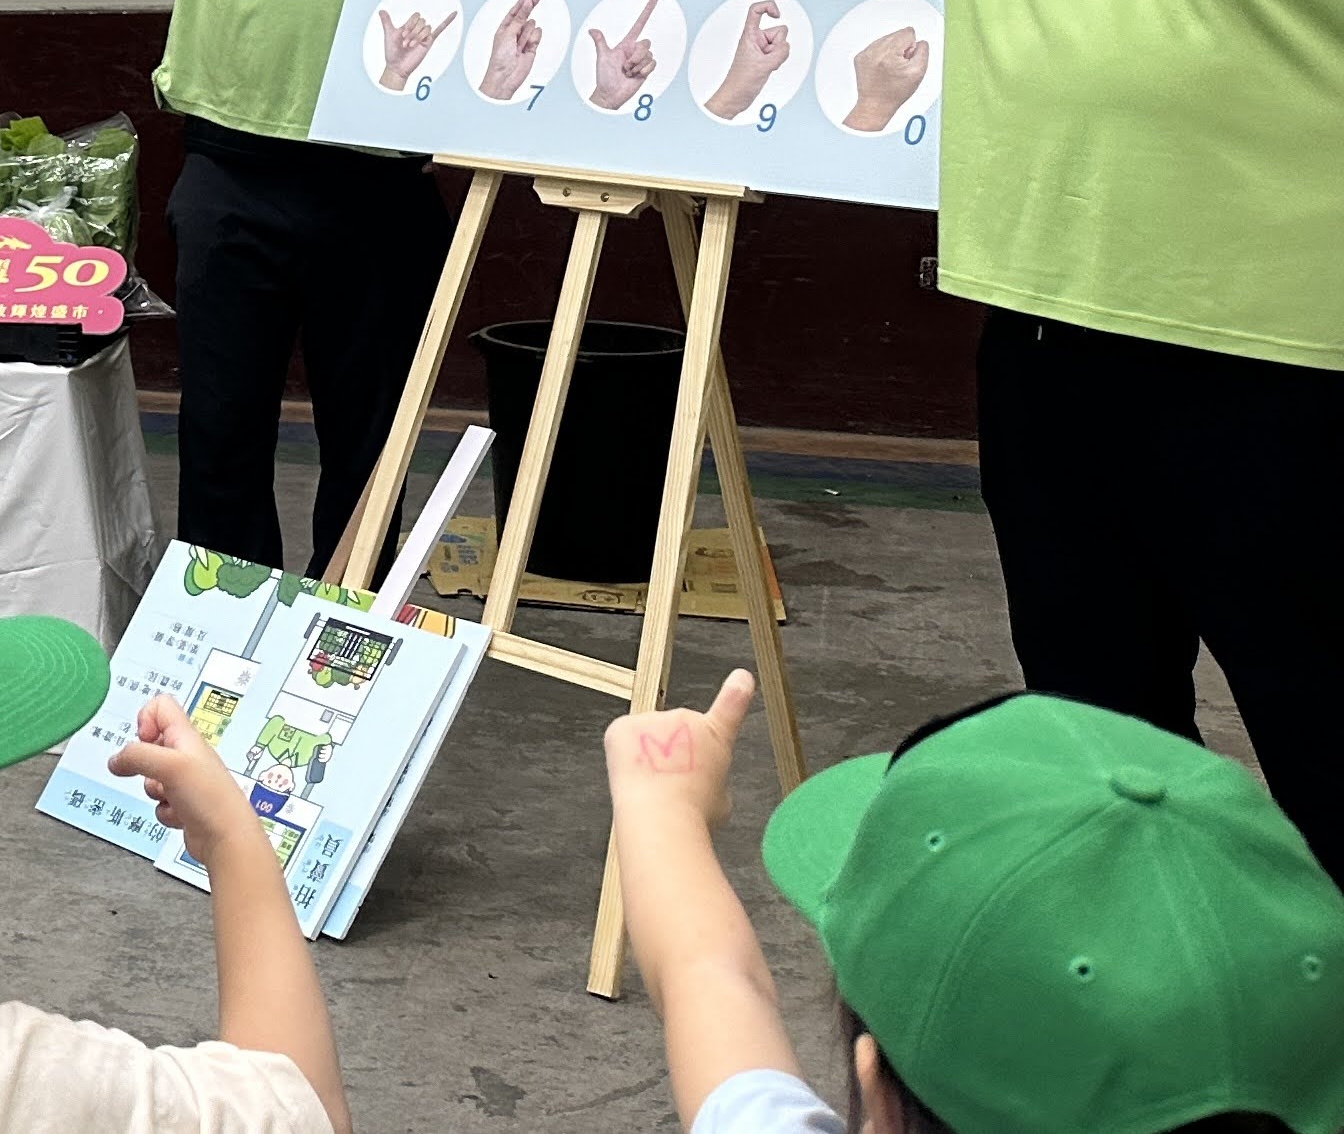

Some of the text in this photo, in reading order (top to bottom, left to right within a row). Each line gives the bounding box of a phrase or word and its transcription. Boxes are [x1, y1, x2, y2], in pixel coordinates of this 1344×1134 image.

[413, 75, 928, 147] 6 7 8 9 0
[14, 254, 110, 293] 50
